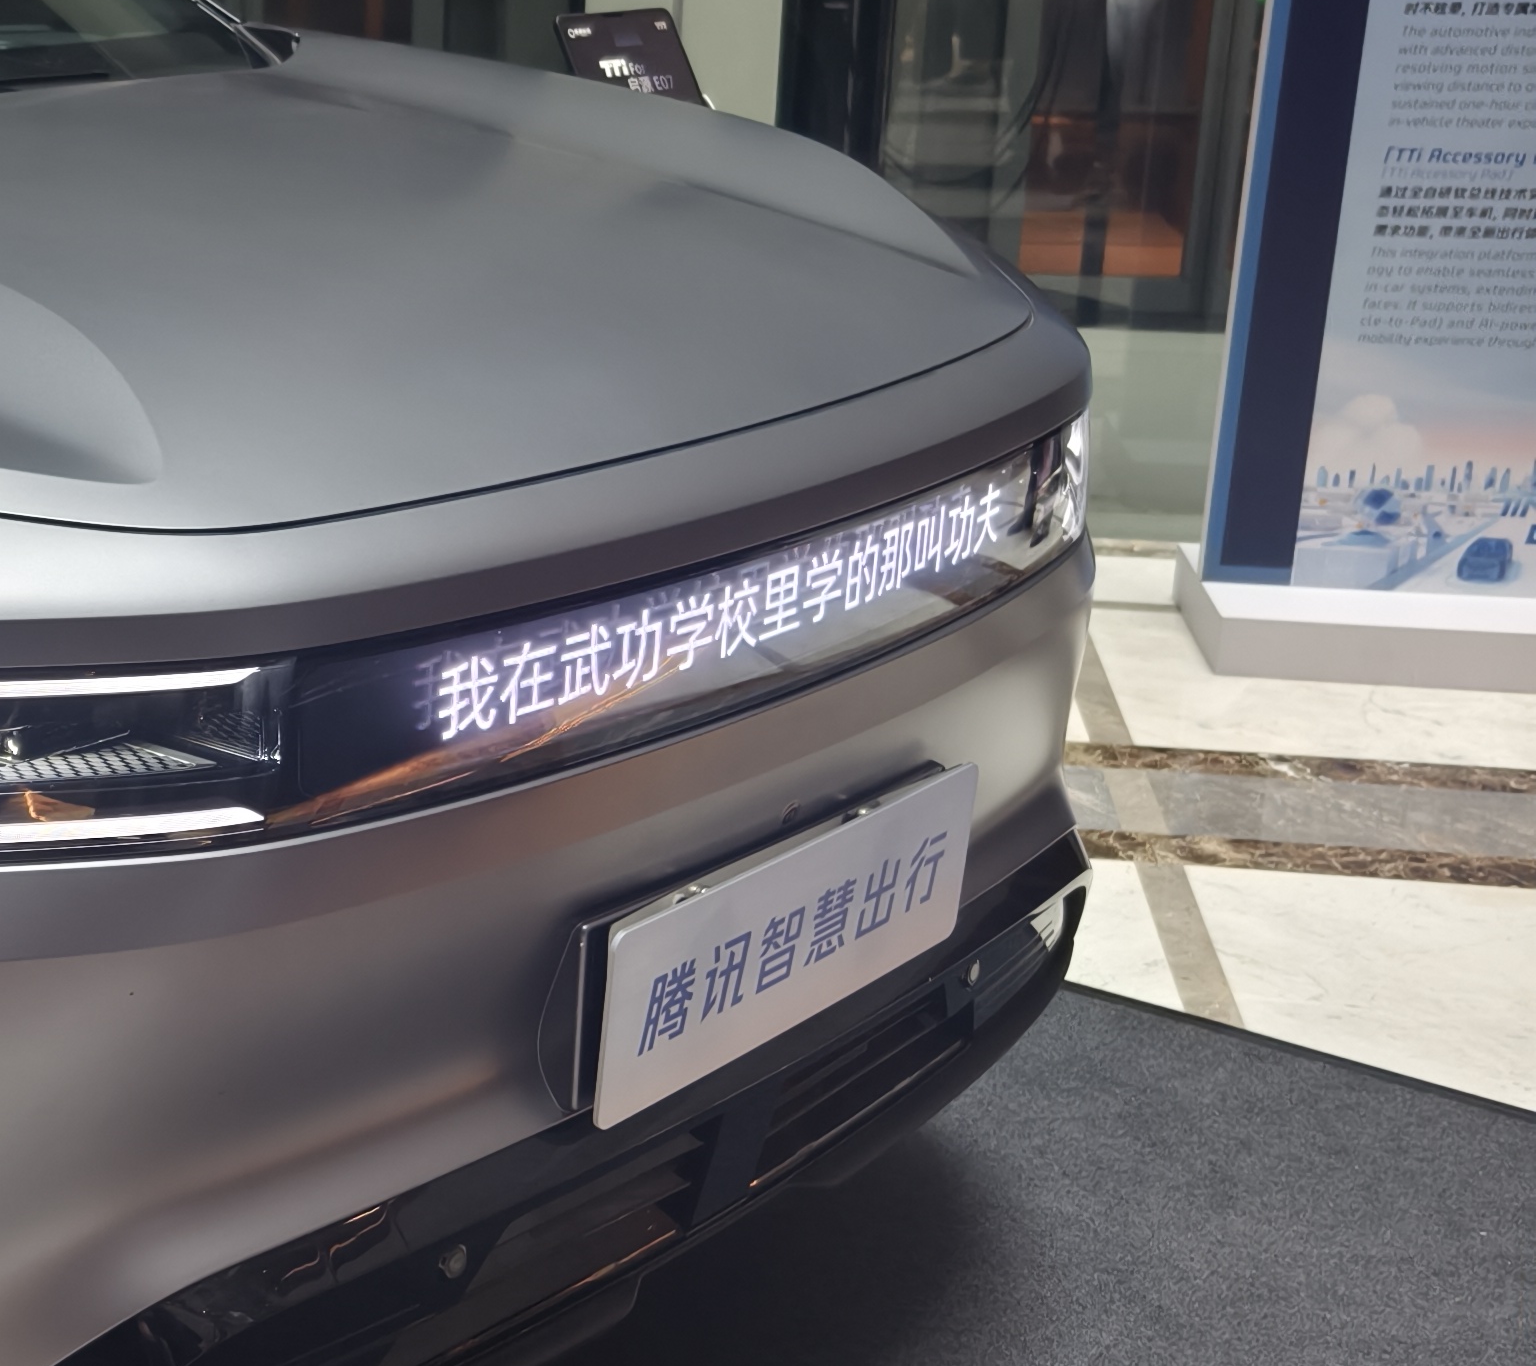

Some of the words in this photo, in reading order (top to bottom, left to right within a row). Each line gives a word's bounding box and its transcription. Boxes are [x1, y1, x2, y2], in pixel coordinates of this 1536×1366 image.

[1398, 44, 1428, 56] with
[654, 75, 674, 91] E07
[1427, 147, 1527, 168] Accessory
[437, 483, 1002, 740] 我在武功学校里学的那叫功夫
[637, 831, 949, 1056] 腾讯智慧出行
